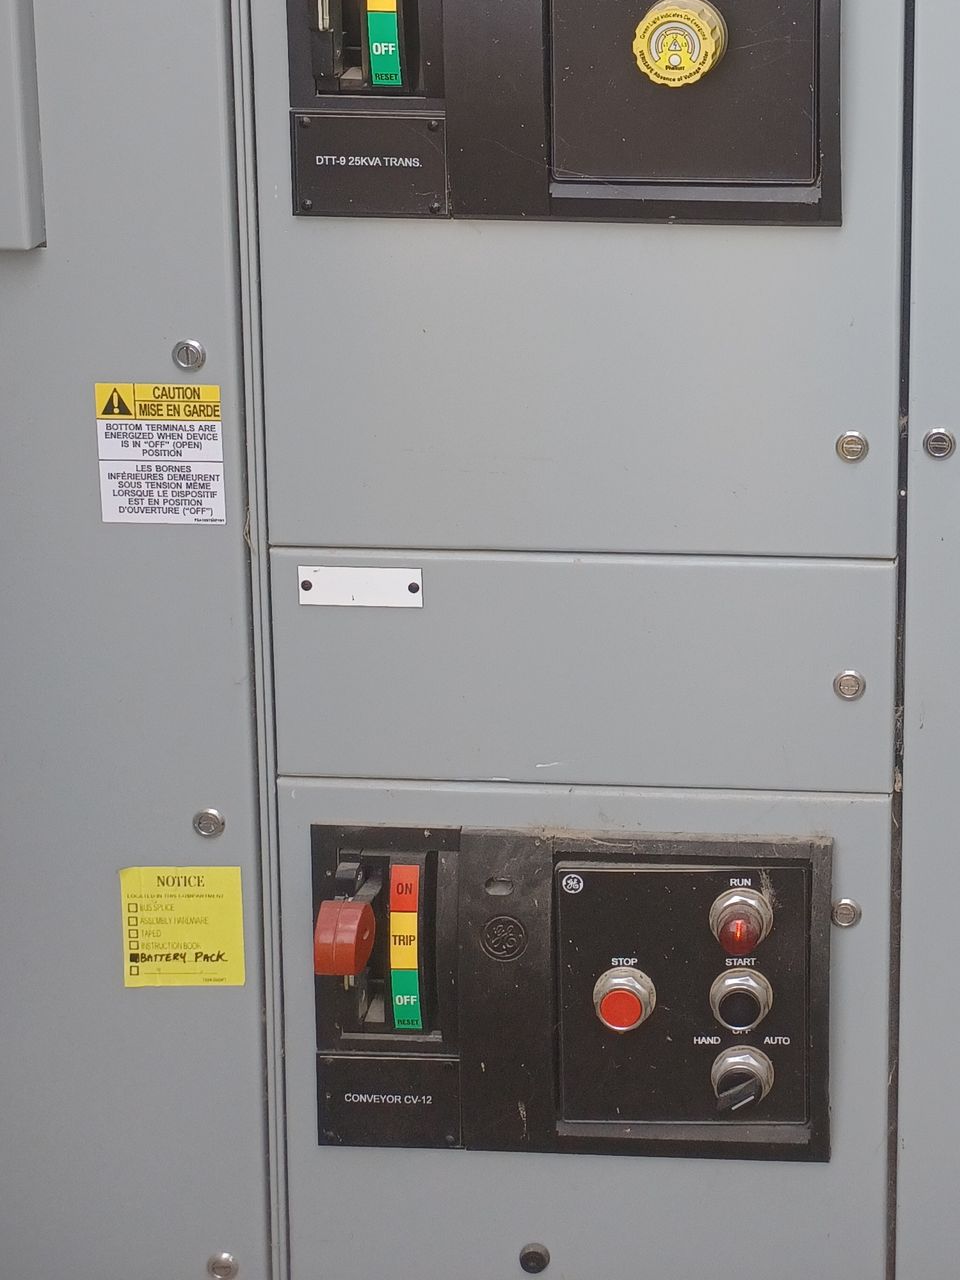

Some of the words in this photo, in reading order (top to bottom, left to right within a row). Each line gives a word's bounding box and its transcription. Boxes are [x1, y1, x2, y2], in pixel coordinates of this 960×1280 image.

[372, 42, 396, 56] OFF
[374, 72, 399, 81] RESET
[315, 155, 346, 166] DTT-9
[348, 156, 382, 167] 25KVA
[383, 157, 423, 168] TRANS.
[152, 386, 201, 400] CAUTION
[138, 403, 164, 417] MISE
[166, 404, 181, 417] EN
[183, 404, 220, 418] GARDE
[105, 423, 143, 431] BOTTOM
[145, 423, 195, 432] TERMINALS
[197, 424, 216, 432] ARE
[104, 431, 154, 440] ENERGIZED
[156, 432, 183, 440] WHEN
[186, 433, 218, 441] DEVICE
[121, 440, 129, 448] IS
[132, 440, 141, 448] IN
[172, 441, 203, 450] (OPEN)
[142, 449, 183, 457] POSITION
[135, 464, 152, 472] LES
[155, 465, 192, 473] BORNES
[167, 474, 220, 482] DEMEURENT
[118, 481, 143, 489] SOUS
[145, 481, 183, 489] TENSION
[112, 489, 155, 498] LORSQUE
[157, 490, 169, 498] LE
[171, 490, 218, 498] DISPOSITIF
[147, 498, 160, 506] EN
[162, 498, 203, 506] POSITION
[156, 875, 205, 888] NOTICE
[729, 878, 752, 886] RUN
[396, 882, 413, 895] ON
[153, 903, 175, 911] SPLICE
[391, 934, 416, 946] TRIP
[140, 952, 187, 963] BATTERY
[194, 950, 228, 963] PACK
[611, 957, 638, 966] STOP
[725, 958, 757, 966] START
[395, 995, 417, 1006] OFF
[693, 1036, 721, 1045] HAND
[763, 1036, 791, 1045] AUTO
[344, 1093, 401, 1104] CONVEYOR
[403, 1095, 433, 1105] CV-12
